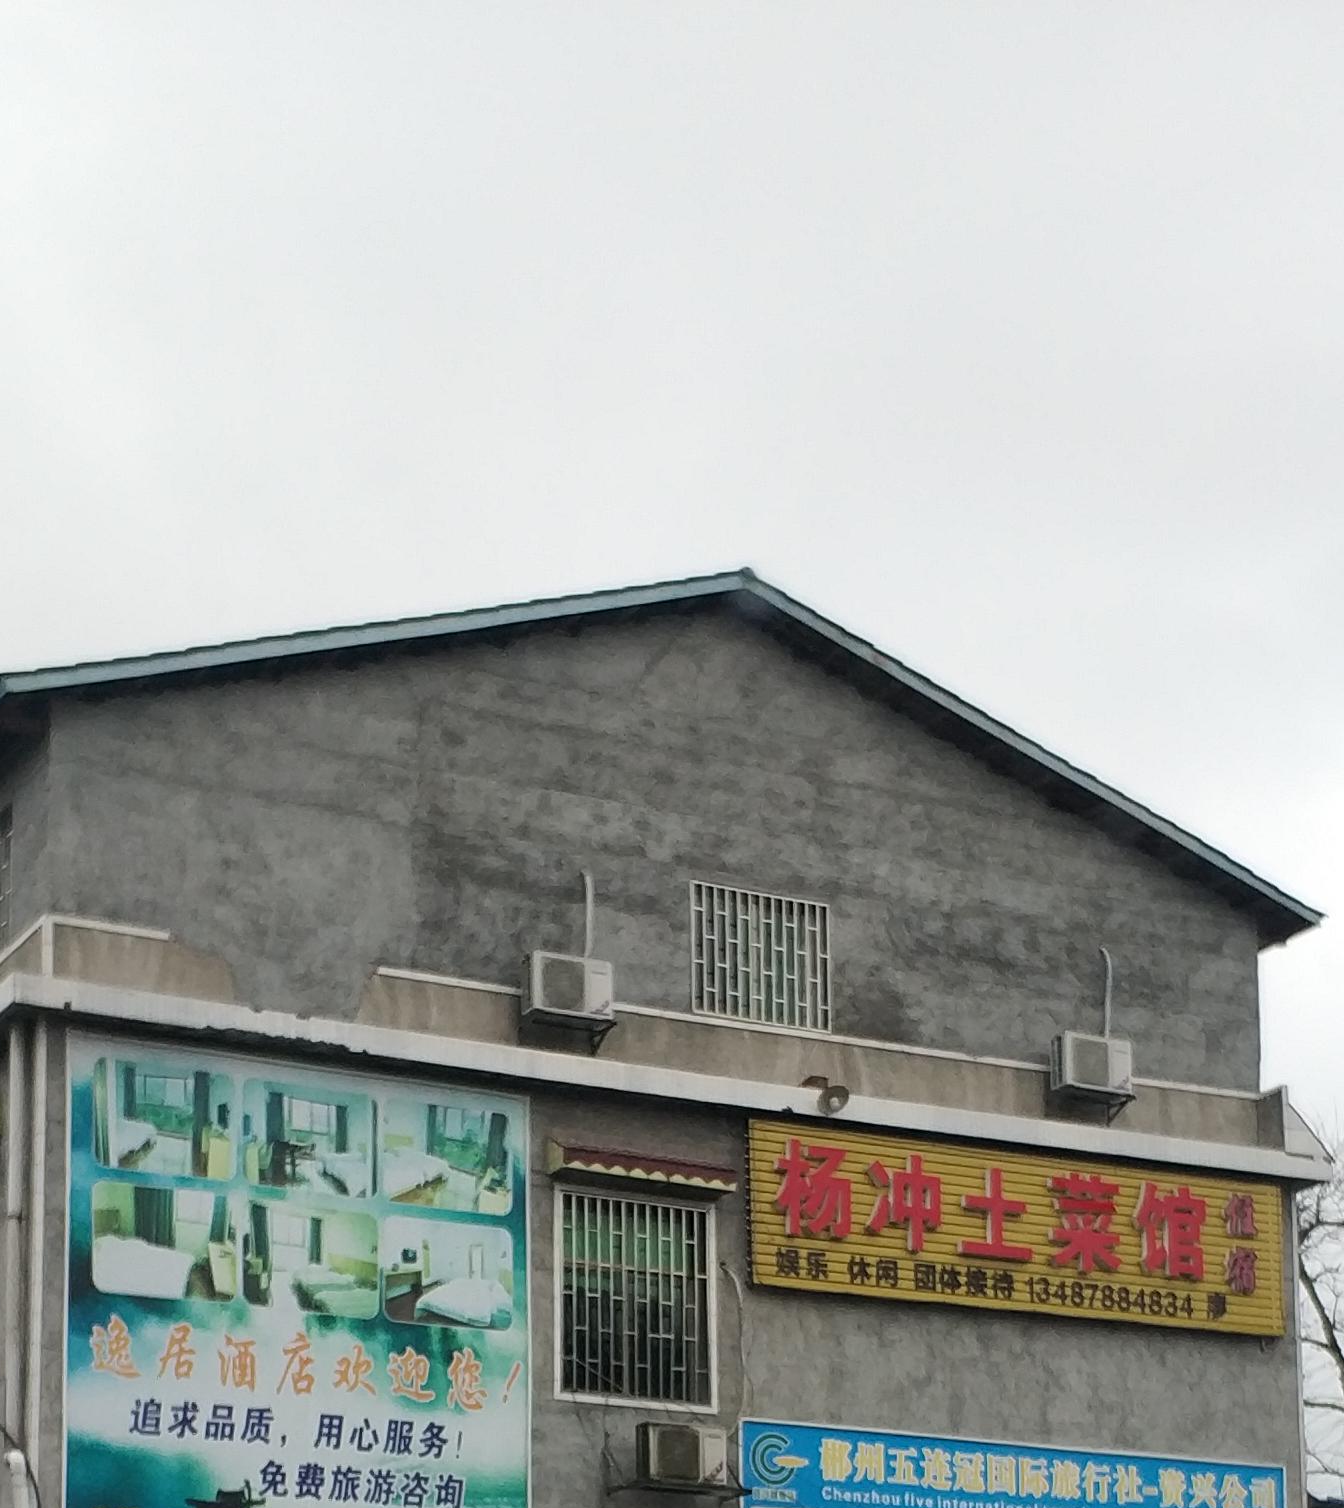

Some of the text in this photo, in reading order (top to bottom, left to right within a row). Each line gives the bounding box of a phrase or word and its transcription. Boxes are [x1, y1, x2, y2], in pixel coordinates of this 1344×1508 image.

[773, 1138, 1206, 1281] 杨冲土菜馆
[775, 1246, 828, 1280] 娱乐
[847, 1255, 899, 1288] 休闲
[913, 1262, 1015, 1300] 团体接待
[821, 1486, 900, 1506] Chenzhou
[904, 1492, 933, 1508] five
